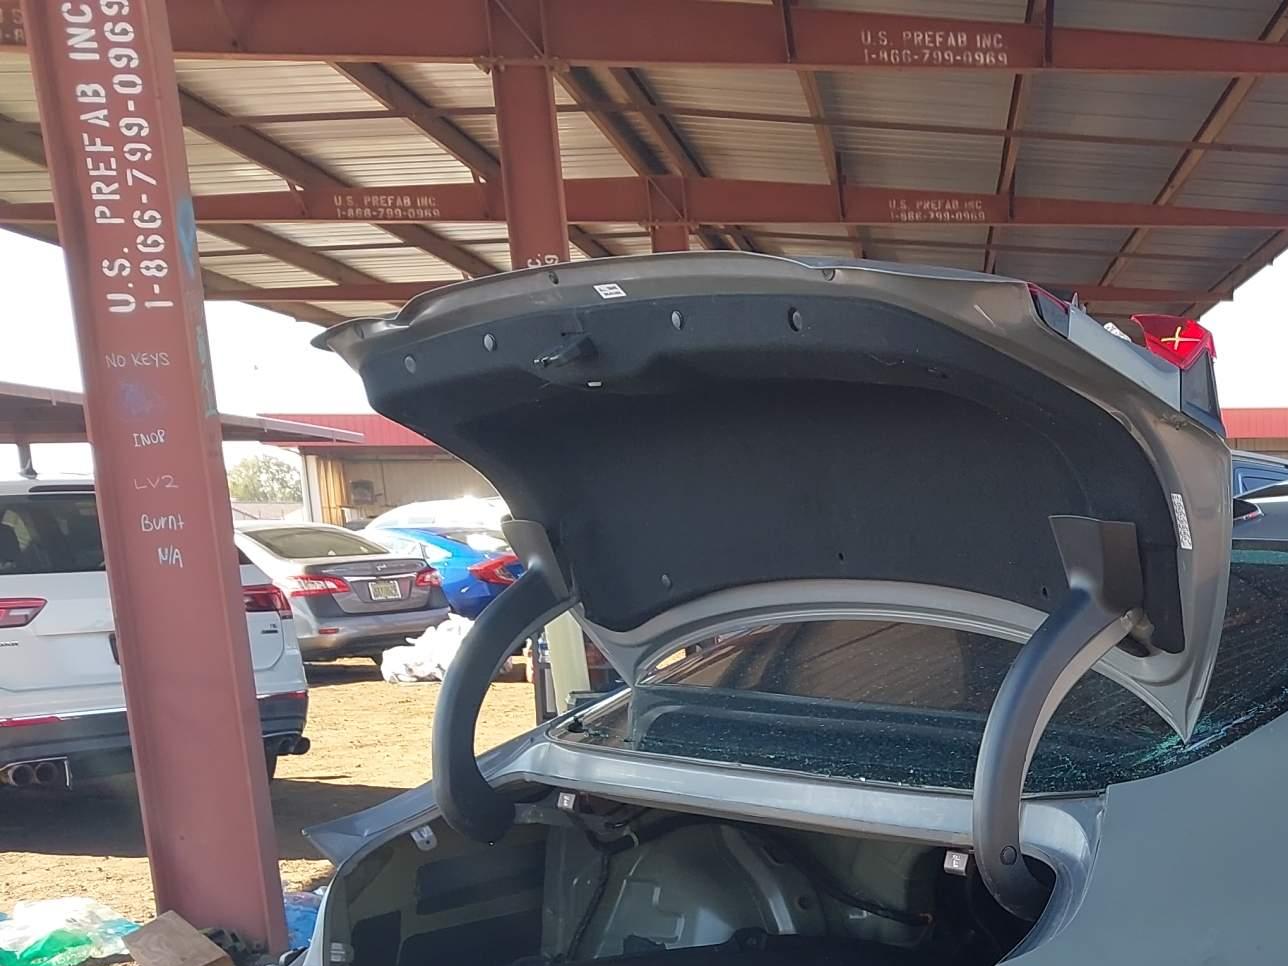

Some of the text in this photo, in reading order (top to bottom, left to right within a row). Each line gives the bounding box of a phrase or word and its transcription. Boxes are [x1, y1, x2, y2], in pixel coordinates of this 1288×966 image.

[861, 30, 893, 46] U.S.
[902, 31, 968, 48] PREFAB
[75, 83, 125, 224] PREFAB
[100, 0, 174, 308] 1-866-799-0969
[363, 195, 411, 207] PREFAB
[102, 247, 136, 313] U.S.
[105, 352, 170, 368] NO KEYS
[133, 429, 166, 447] INOP
[141, 514, 184, 532] Burnt
[158, 546, 183, 568] N/A
